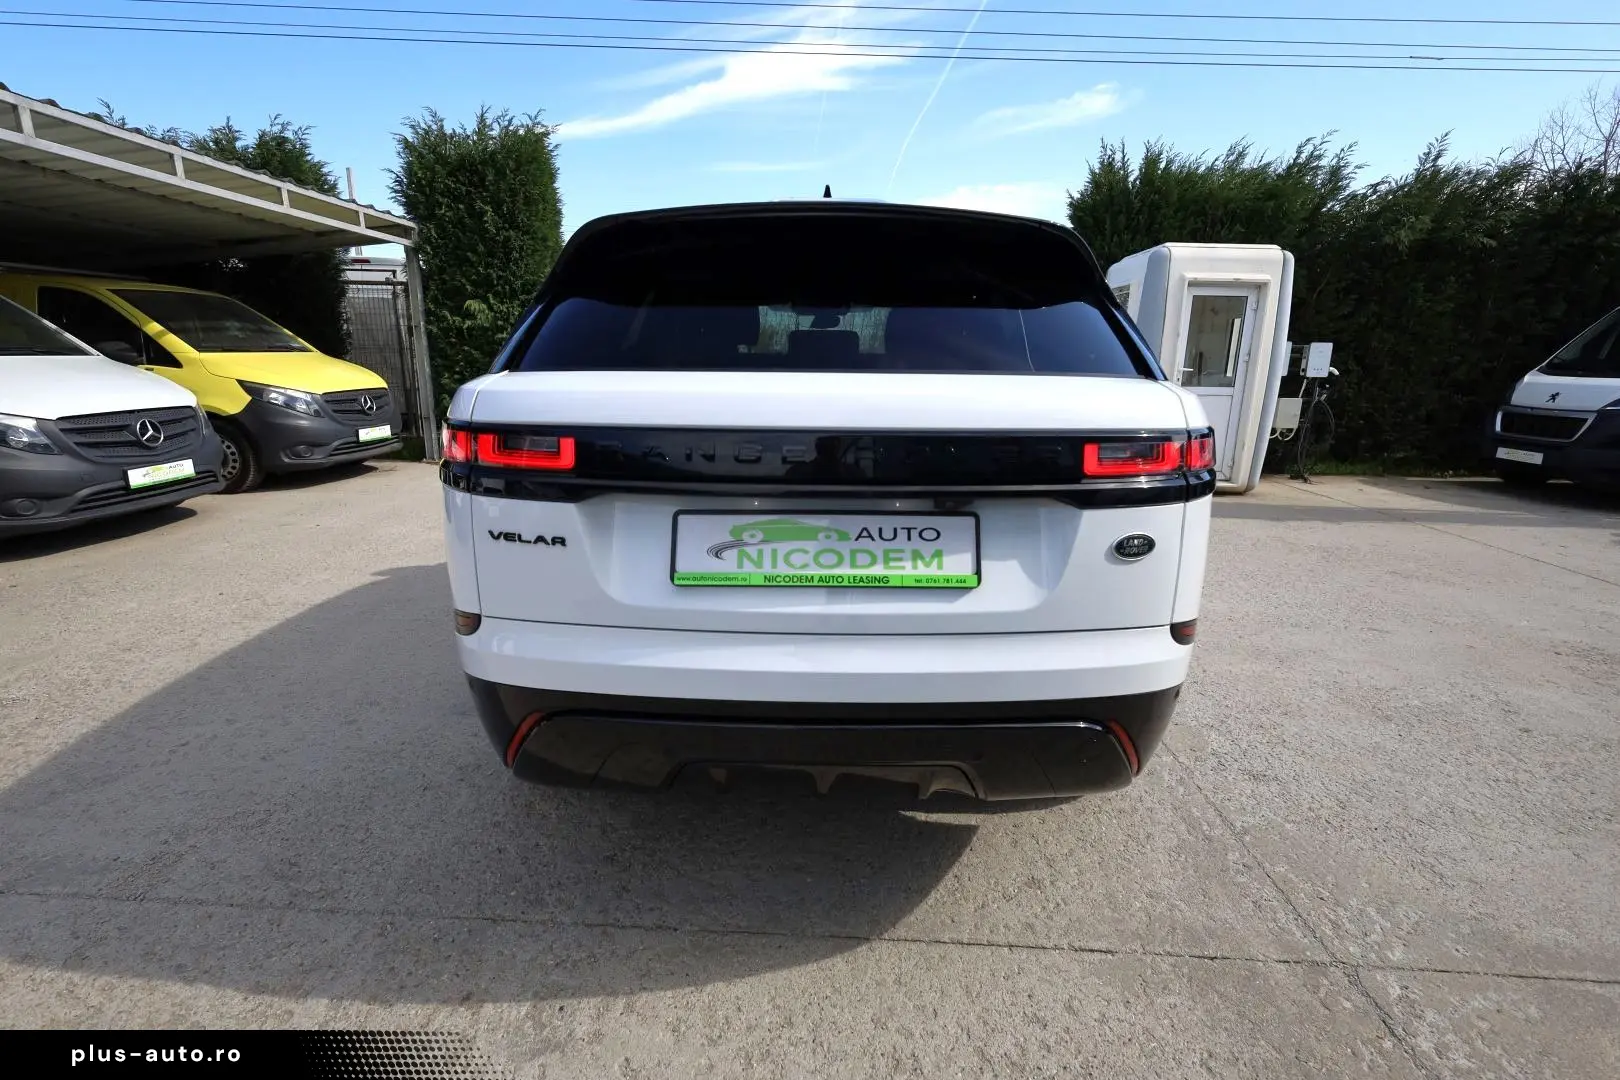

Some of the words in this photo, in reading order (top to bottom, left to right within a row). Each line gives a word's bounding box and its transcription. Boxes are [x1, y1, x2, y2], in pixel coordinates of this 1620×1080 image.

[488, 529, 567, 547] VELAR
[854, 527, 941, 542] AUTO
[737, 547, 943, 571] NICODEM
[676, 575, 747, 583] www.autonicodem.ro
[763, 574, 814, 584] NICODEM
[817, 575, 844, 584] AUTO
[848, 576, 890, 585] LEASING
